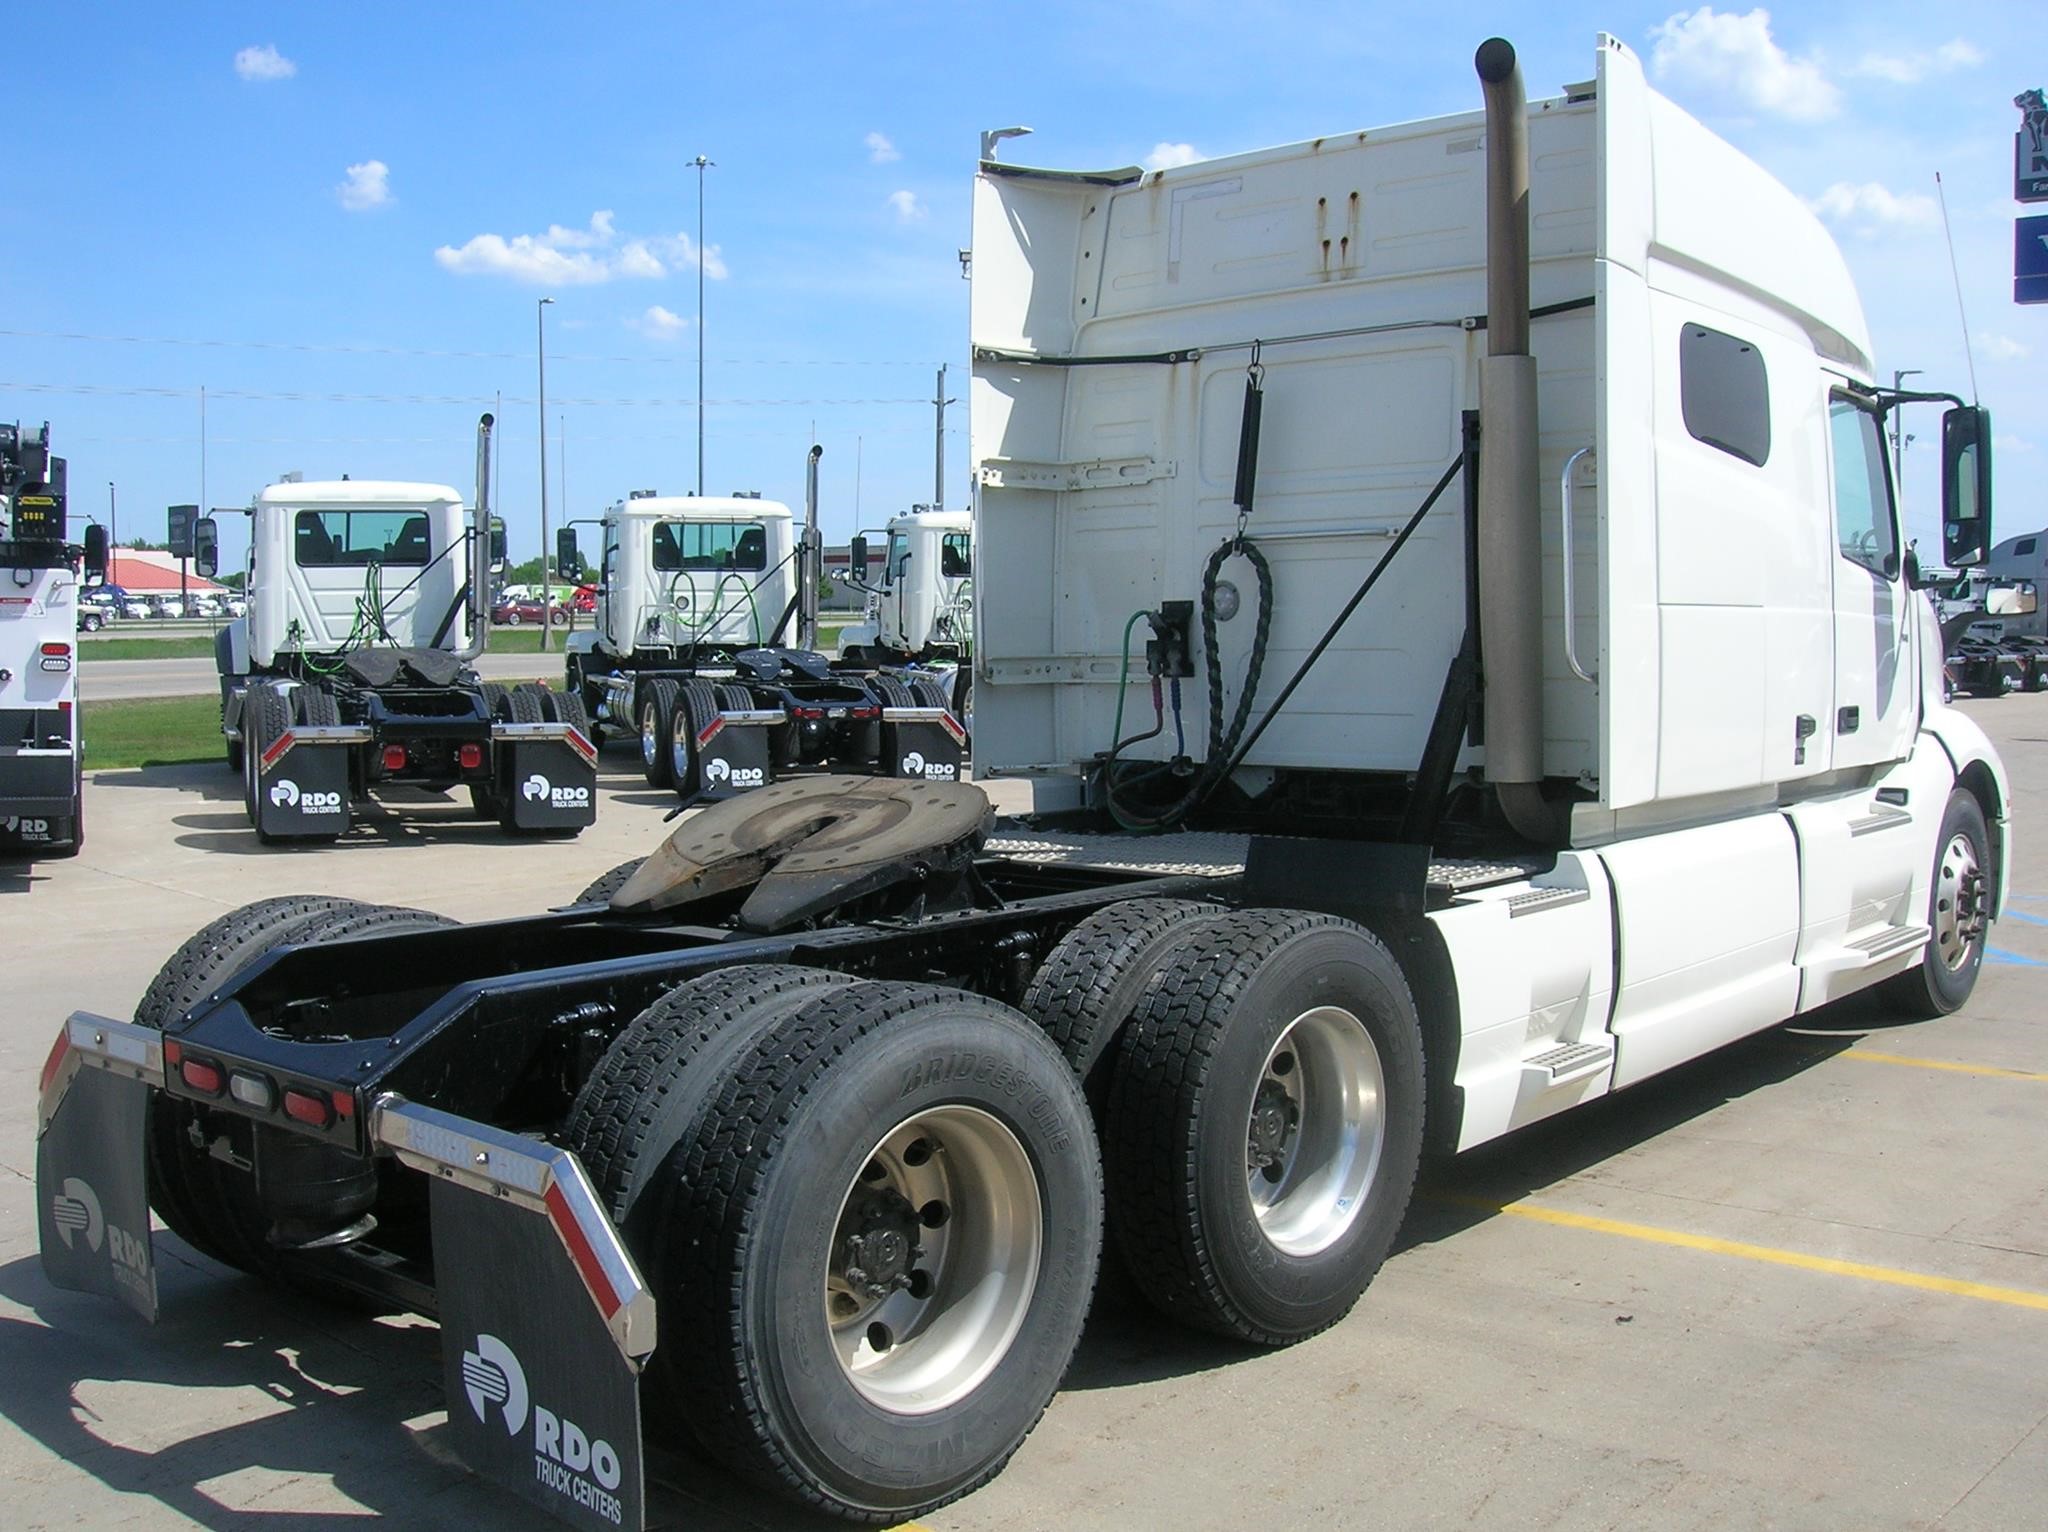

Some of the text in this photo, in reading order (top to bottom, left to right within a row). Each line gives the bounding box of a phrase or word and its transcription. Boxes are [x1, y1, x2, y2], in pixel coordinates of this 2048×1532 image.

[731, 768, 763, 780] RDO
[925, 764, 955, 774] RDO
[301, 792, 341, 806] RDO
[551, 787, 589, 800] RDO
[21, 819, 48, 832] RD
[900, 1053, 1071, 1153] BRIDGESTONE
[107, 1224, 147, 1276] RDO
[535, 1405, 621, 1490] RDO
[535, 1455, 622, 1524] TRUCK CENTERS
